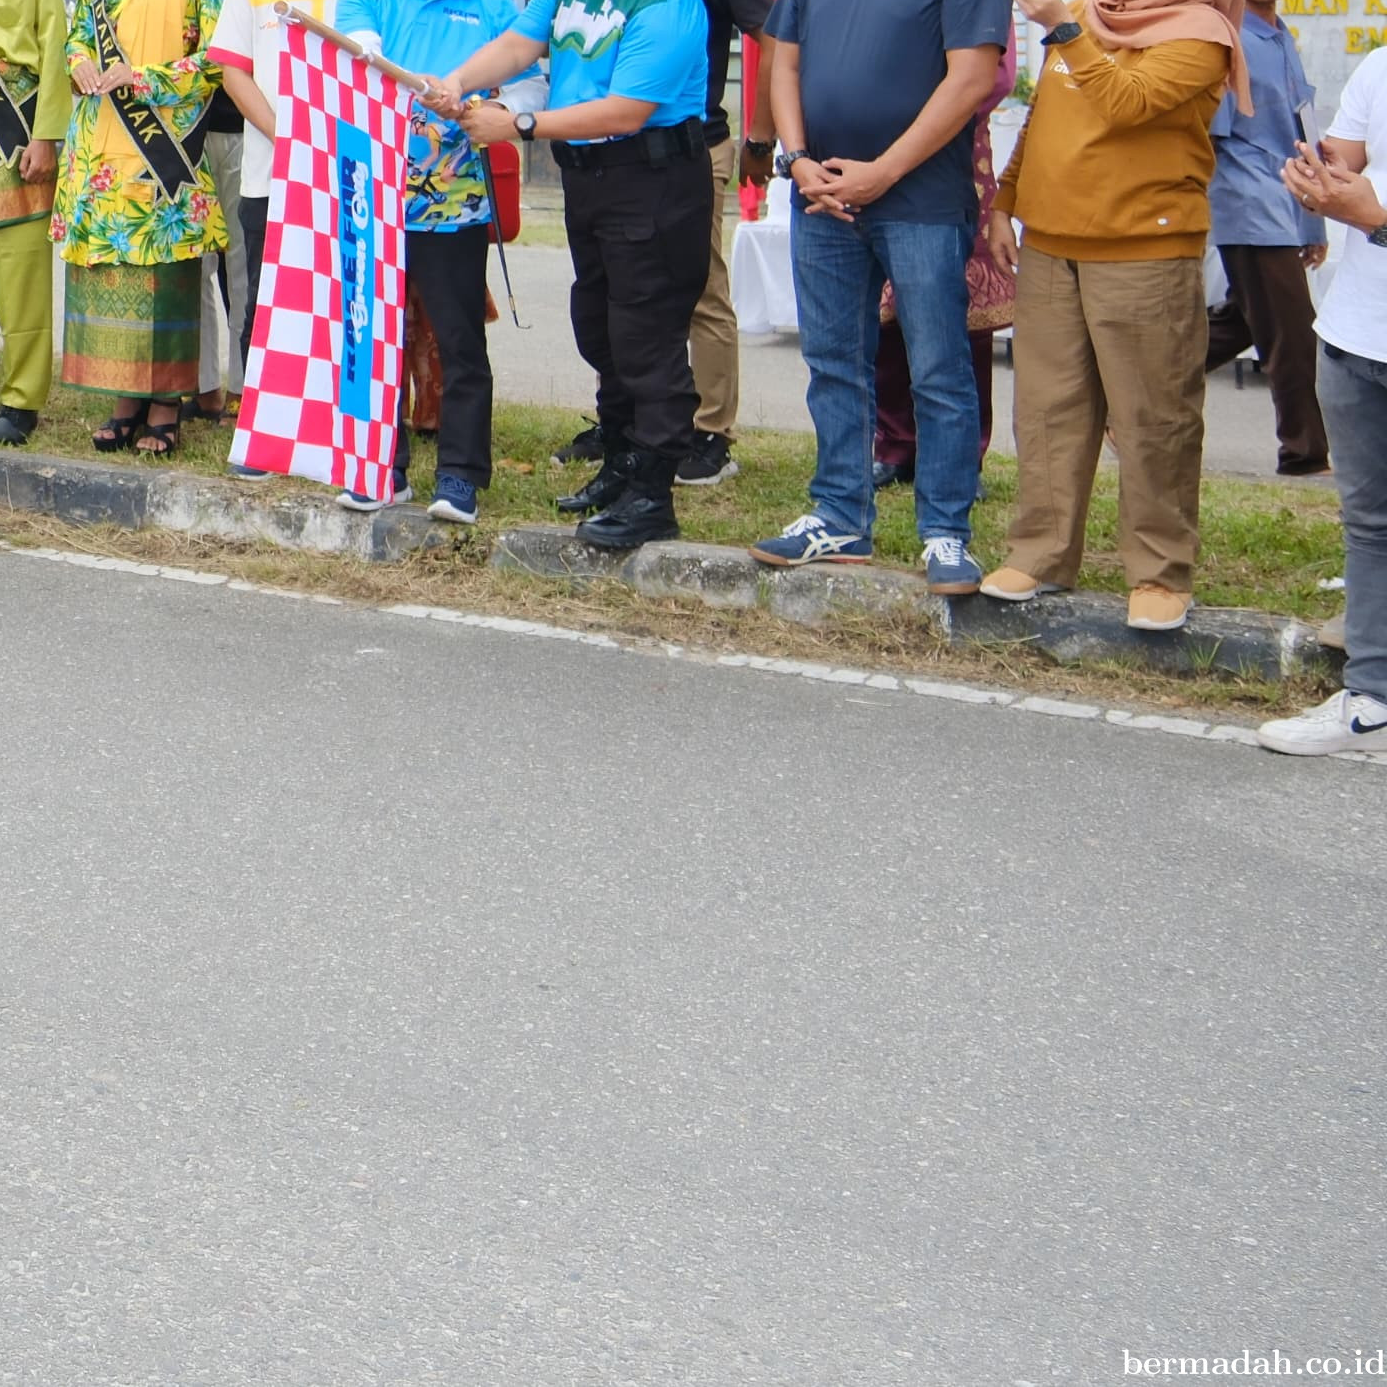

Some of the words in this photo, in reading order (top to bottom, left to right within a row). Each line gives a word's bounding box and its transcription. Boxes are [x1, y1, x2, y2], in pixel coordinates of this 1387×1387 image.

[94, 4, 122, 71] DARA
[115, 84, 164, 145] SIAK
[341, 155, 358, 246] FOR
[351, 158, 370, 231] City
[342, 251, 357, 384] RACE
[349, 237, 369, 345] Green
